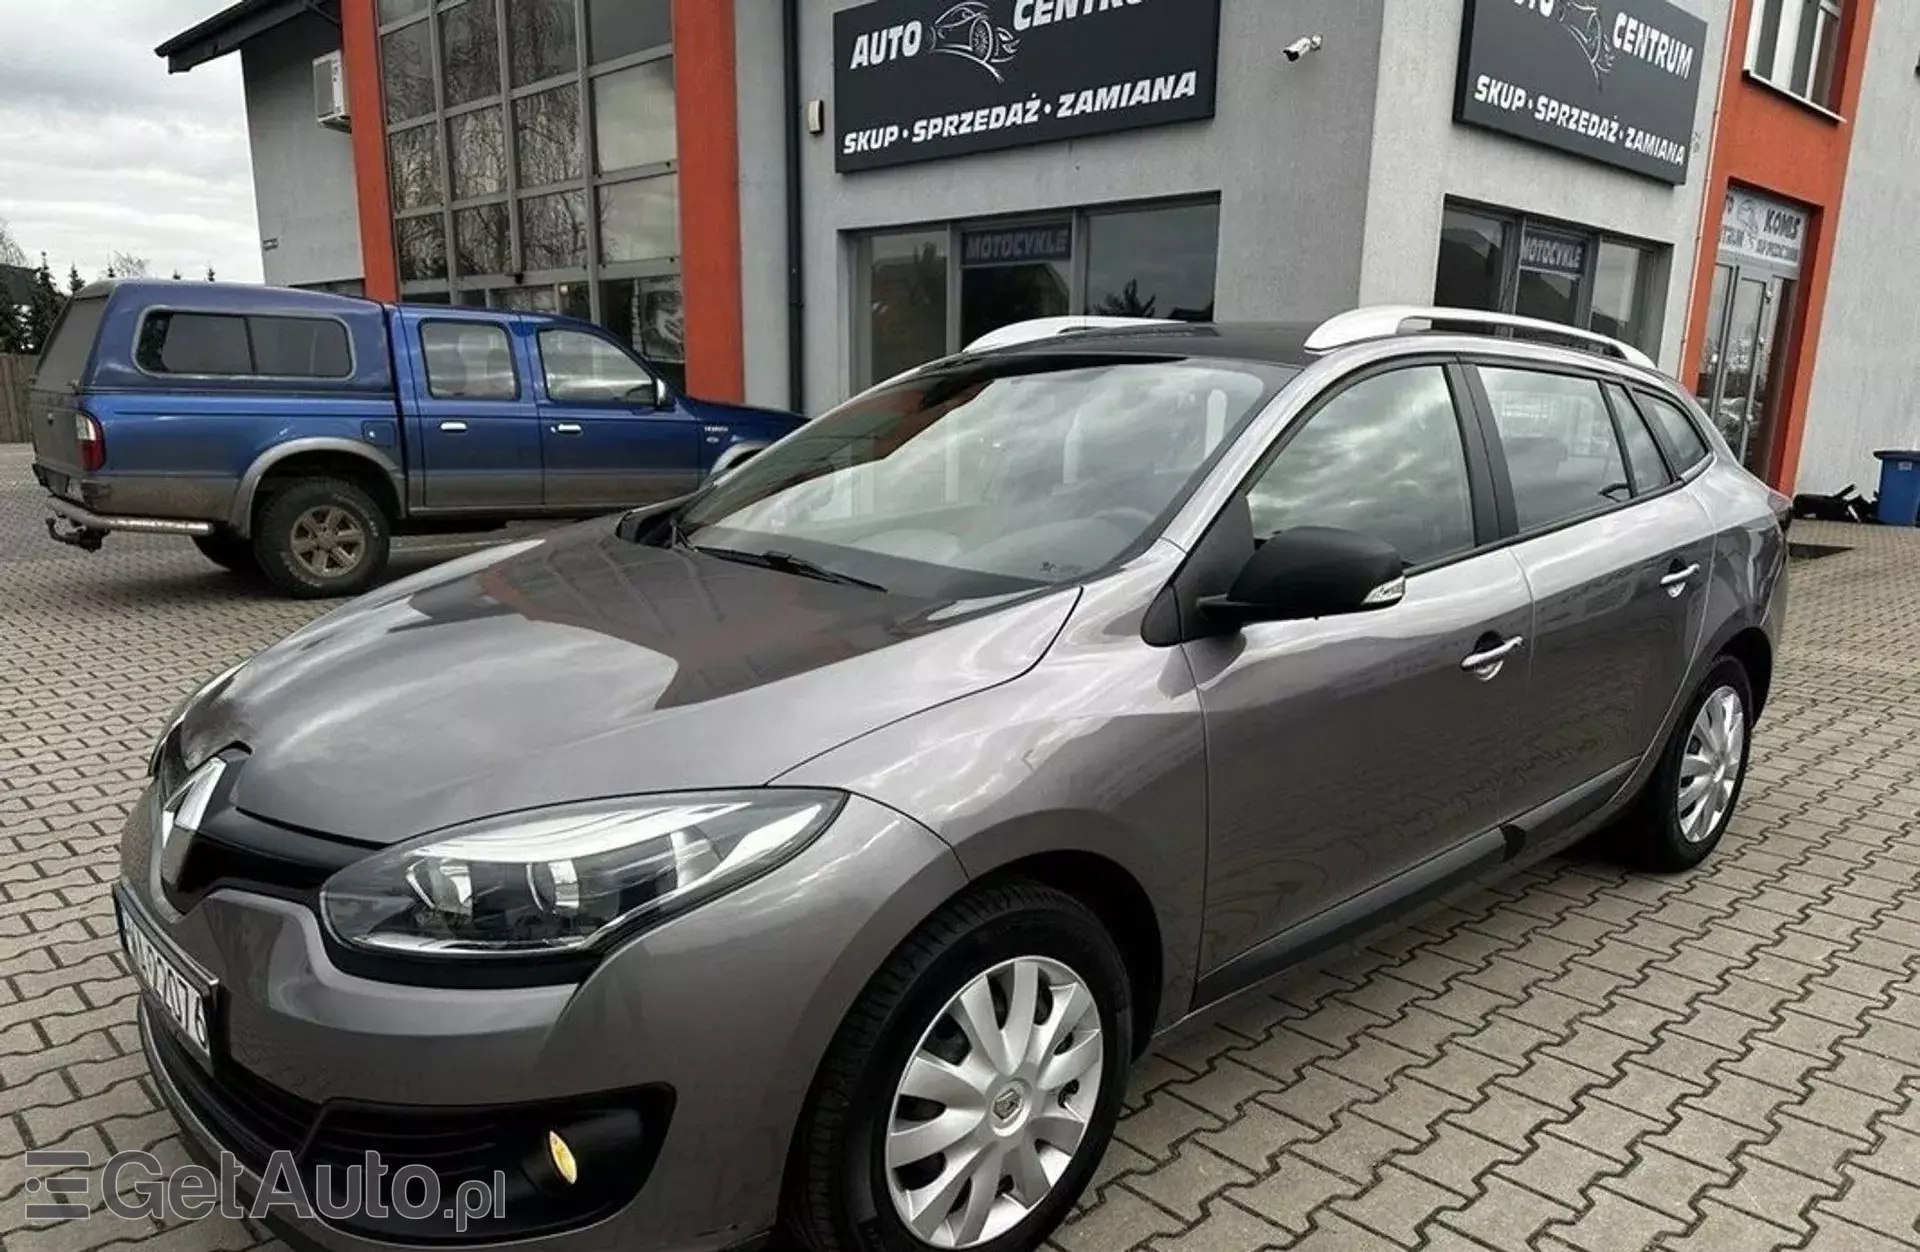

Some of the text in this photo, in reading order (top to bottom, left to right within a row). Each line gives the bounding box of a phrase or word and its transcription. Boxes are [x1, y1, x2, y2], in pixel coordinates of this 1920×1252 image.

[850, 20, 922, 69] AUTO
[1612, 12, 1694, 79] CENTRUM
[843, 70, 1196, 154] SKUP SPRZEDAŻ ZAMIANA
[1474, 75, 1687, 166] SKUP SPRZEDAŻ ZAMIANA
[966, 229, 1069, 259] MOTOCYKLE
[1521, 236, 1583, 268] MOTOCYKLE
